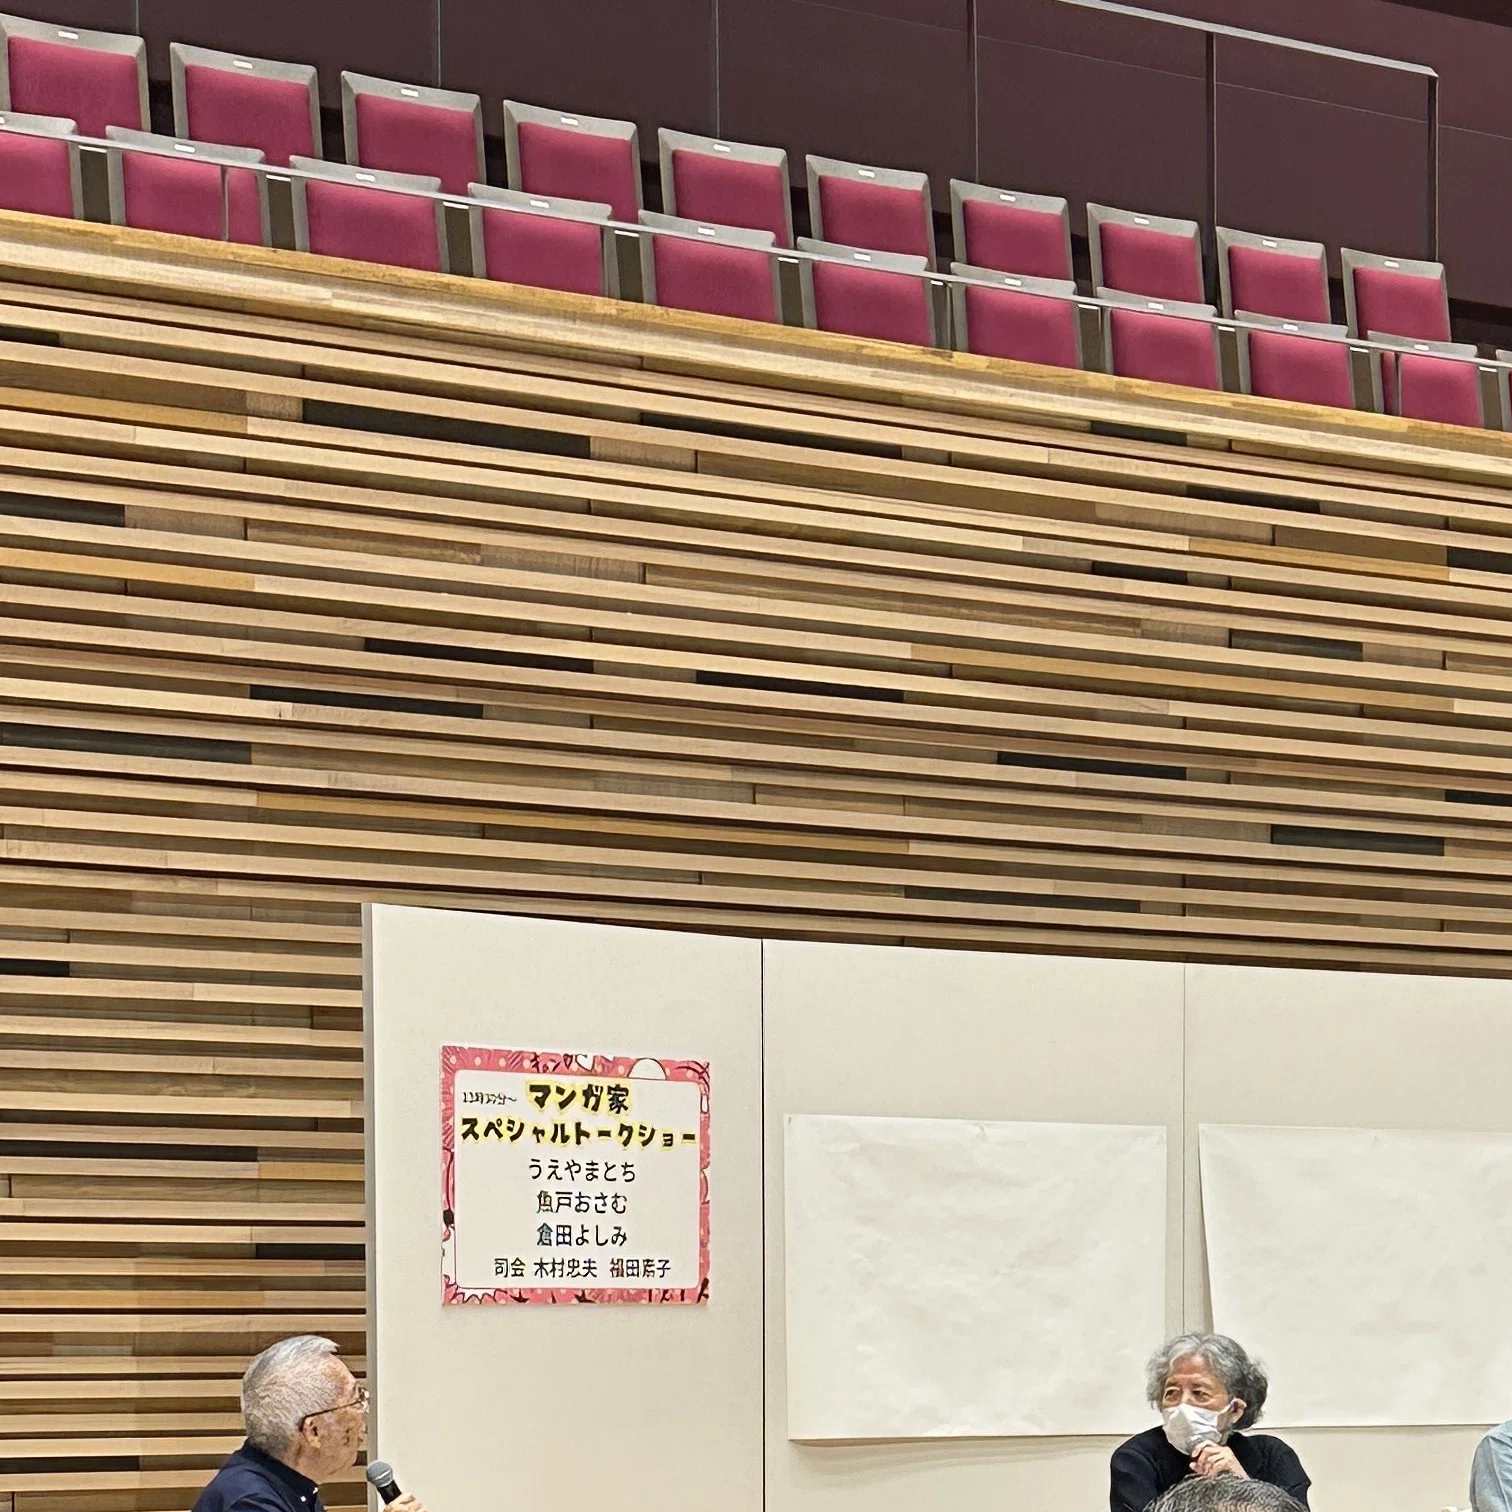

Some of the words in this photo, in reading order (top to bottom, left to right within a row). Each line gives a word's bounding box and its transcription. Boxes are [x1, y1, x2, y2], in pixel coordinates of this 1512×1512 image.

[529, 1083, 629, 1115] マンガ家
[461, 1117, 696, 1147] スペシャルトークショー
[528, 1158, 636, 1183] うえやまとち
[536, 1189, 628, 1215] 魚戸おさむ
[536, 1222, 628, 1247] 倉田よしみ
[494, 1257, 526, 1278] 司会
[533, 1257, 598, 1279] 木村忠夫
